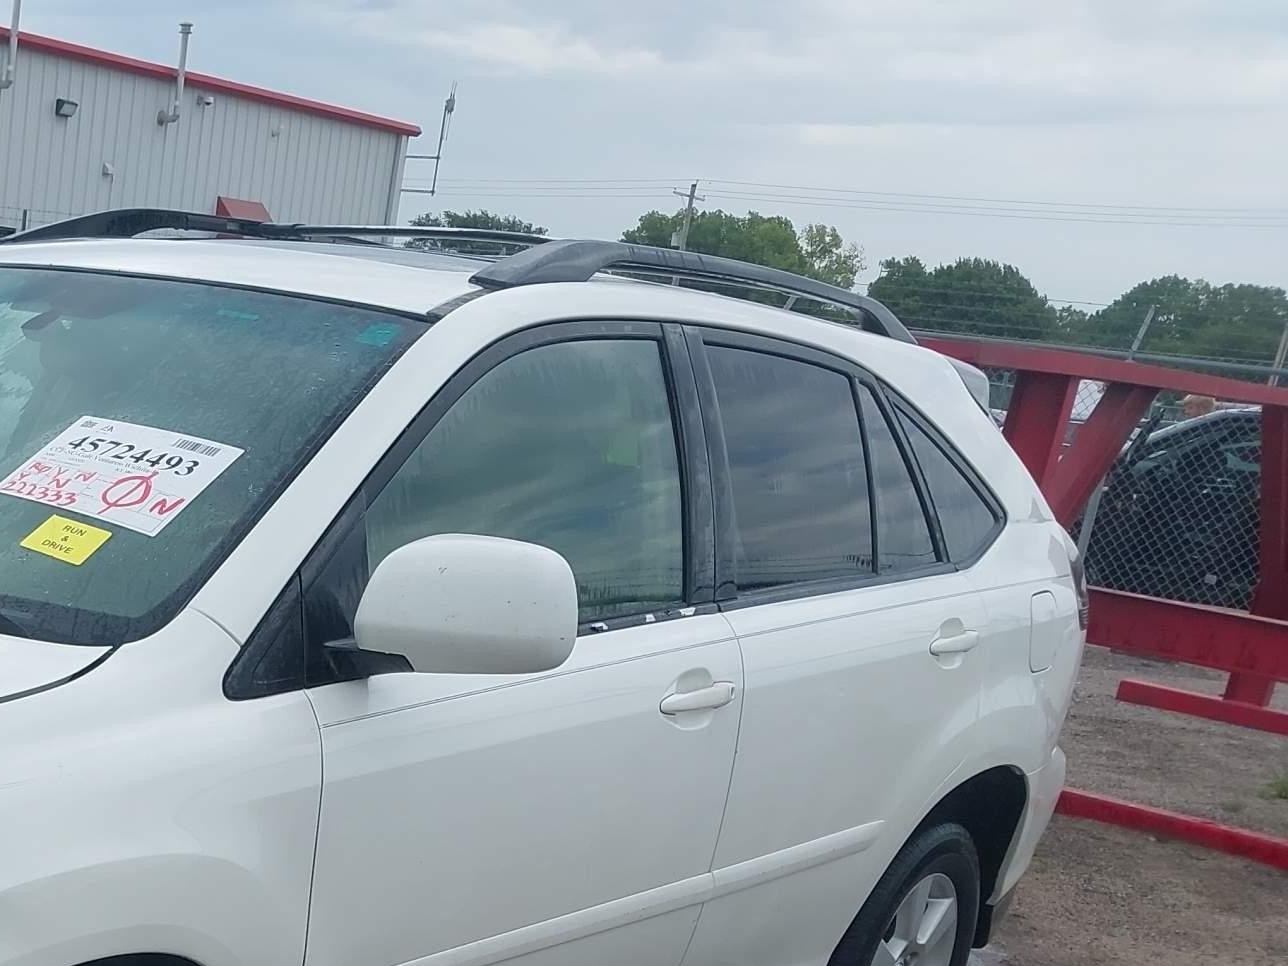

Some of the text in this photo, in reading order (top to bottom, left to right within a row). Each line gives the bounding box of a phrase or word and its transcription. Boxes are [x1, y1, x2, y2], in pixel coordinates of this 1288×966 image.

[68, 436, 200, 477] 45724493
[0, 481, 77, 506] 222333
[62, 525, 88, 537] RUN
[41, 539, 74, 554] DRIVE
